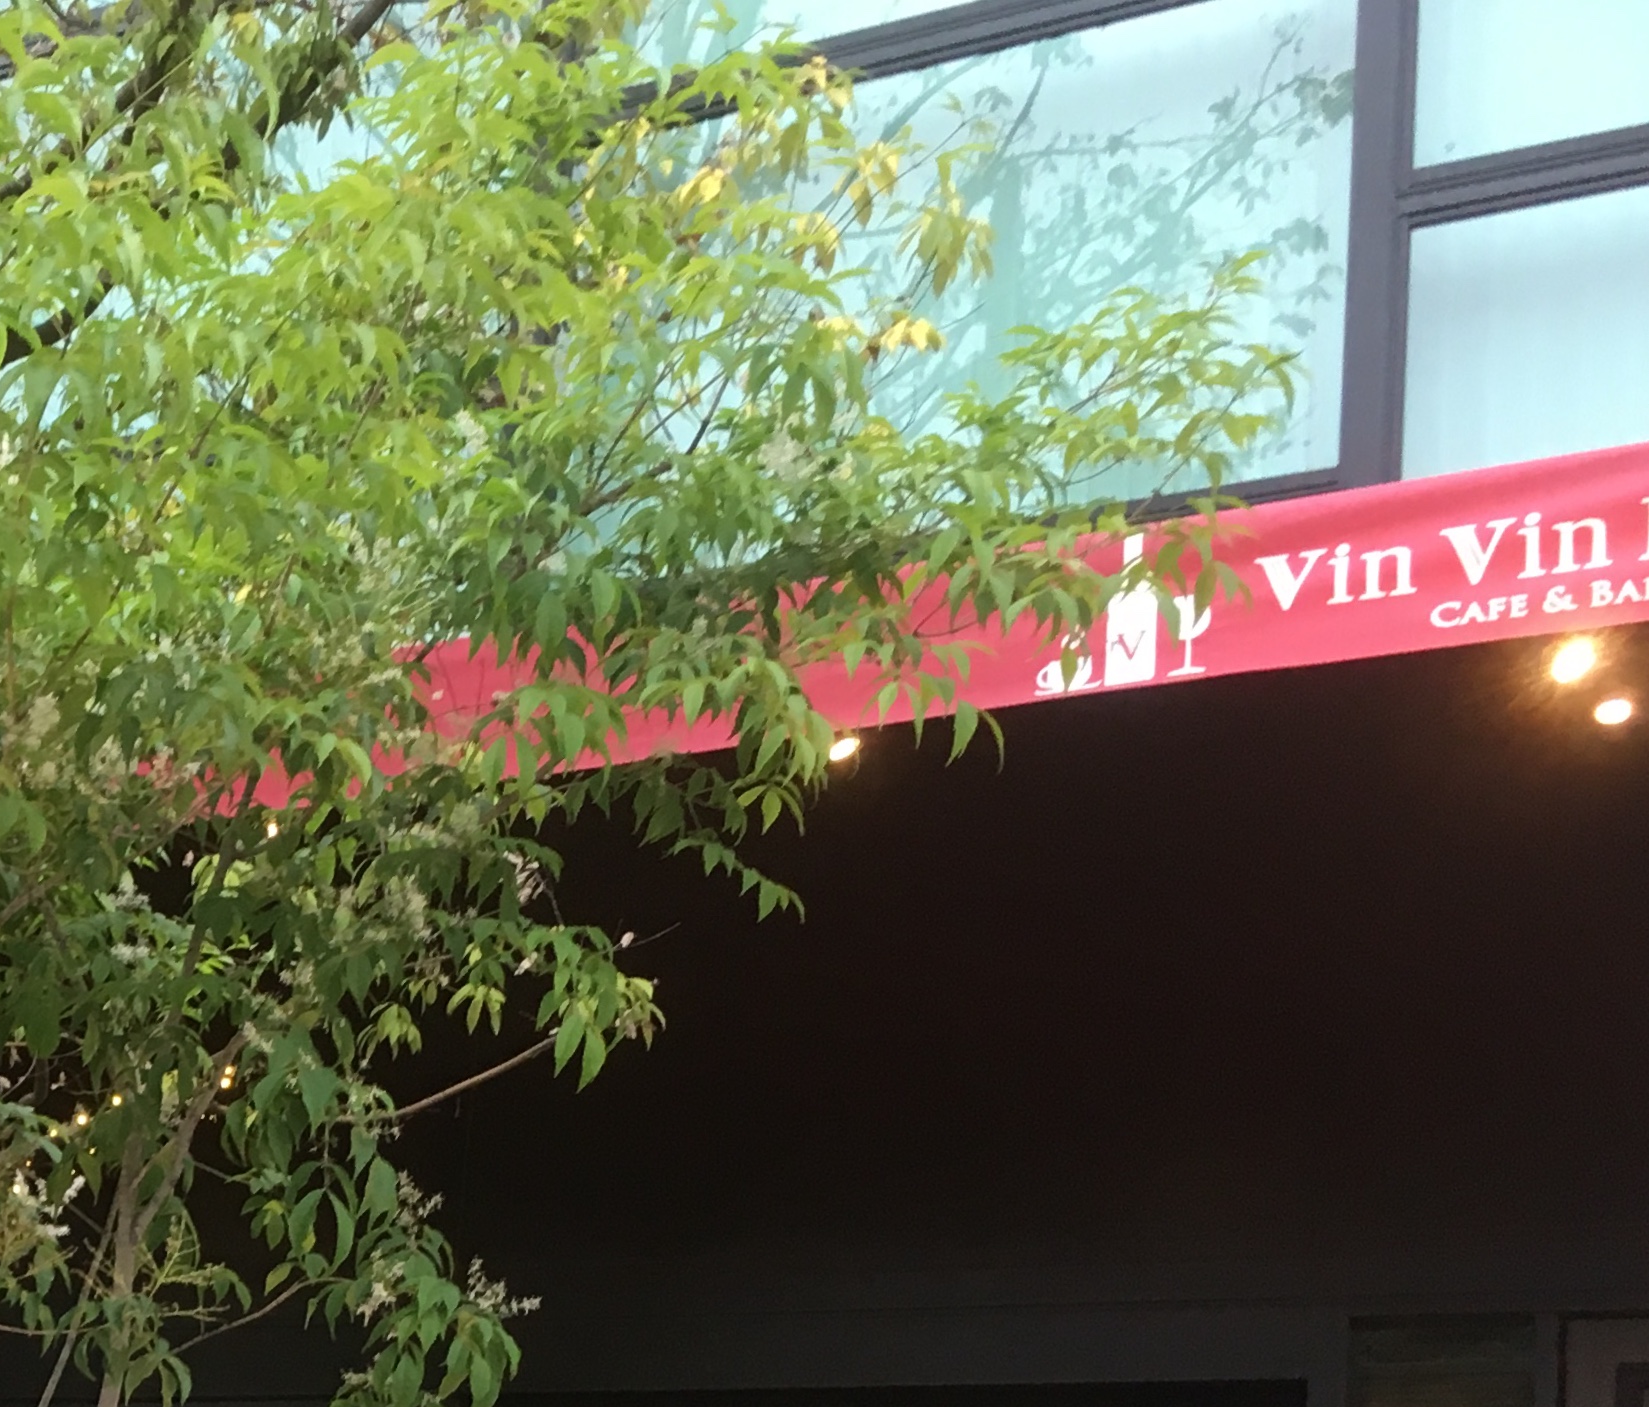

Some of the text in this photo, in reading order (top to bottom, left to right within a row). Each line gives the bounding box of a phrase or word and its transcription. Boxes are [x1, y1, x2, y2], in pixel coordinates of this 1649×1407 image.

[1254, 542, 1418, 611] Vin
[1439, 512, 1614, 586] Vin
[1430, 594, 1529, 628] CAFE
[1542, 585, 1579, 614] &
